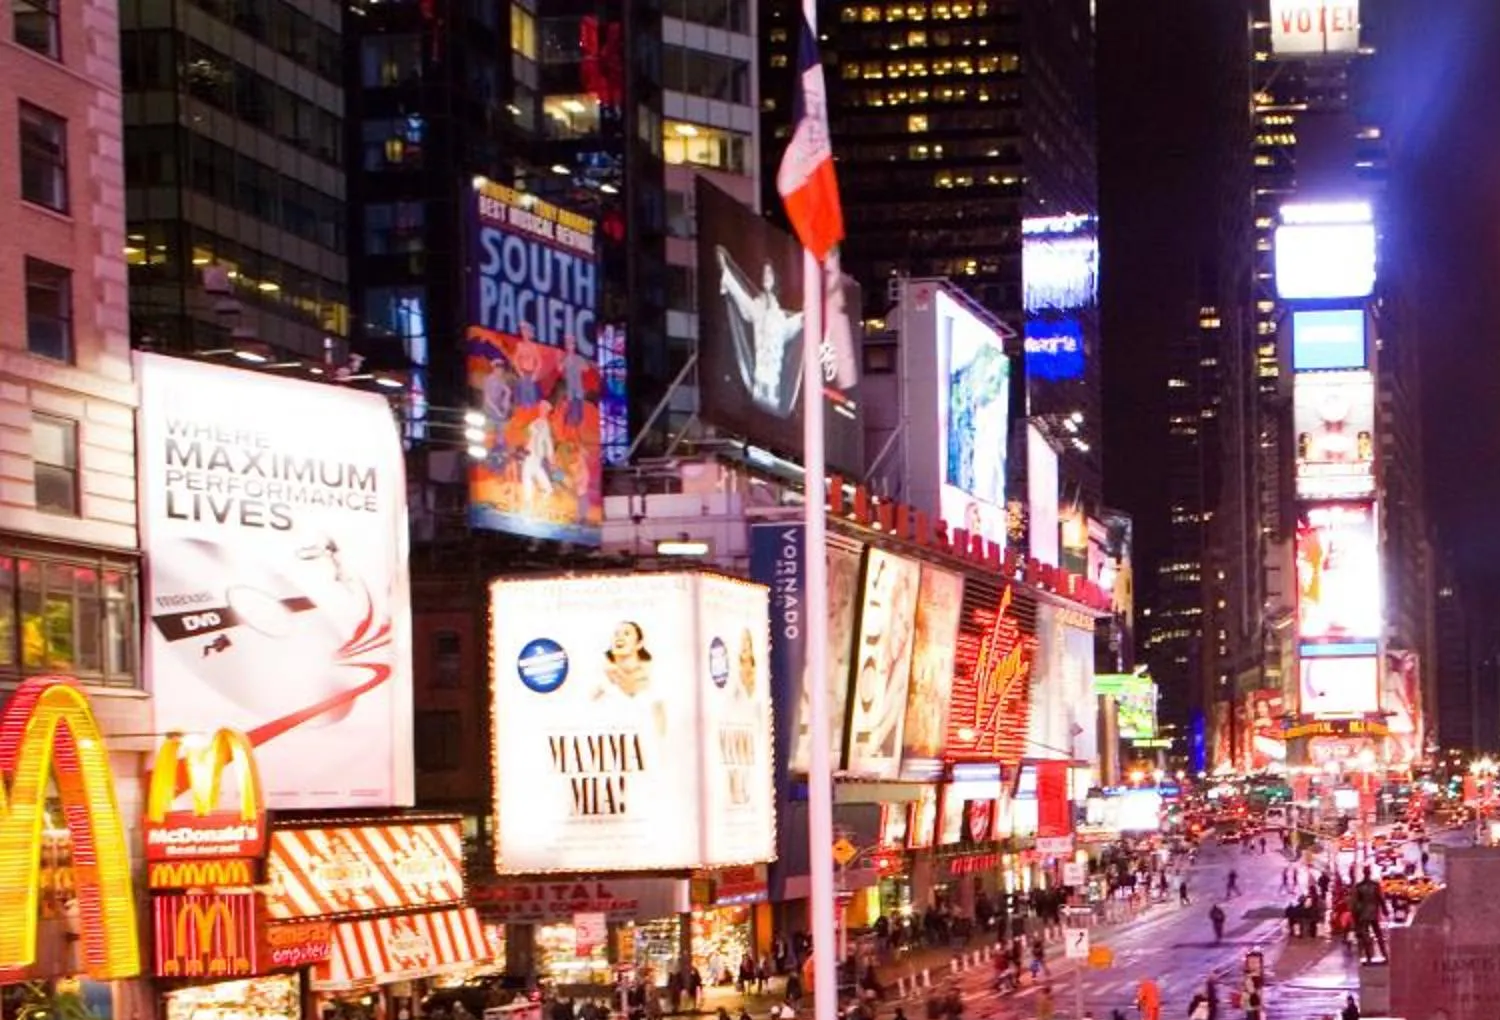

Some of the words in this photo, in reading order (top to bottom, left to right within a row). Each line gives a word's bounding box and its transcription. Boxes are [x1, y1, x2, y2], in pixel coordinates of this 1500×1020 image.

[1281, 5, 1353, 33] VOTE!
[479, 227, 595, 308] SOUTH
[479, 275, 595, 356] PACIFIC
[165, 416, 271, 449] WHERE
[165, 437, 378, 493] MAXIMUM
[165, 468, 378, 514] PERFORMANCE
[166, 490, 293, 531] LIVES
[782, 528, 799, 639] VORNADO
[181, 611, 221, 631] DVD
[548, 733, 645, 774] MAMMA
[571, 776, 626, 817] MIA!
[148, 826, 257, 845] McDonald's
